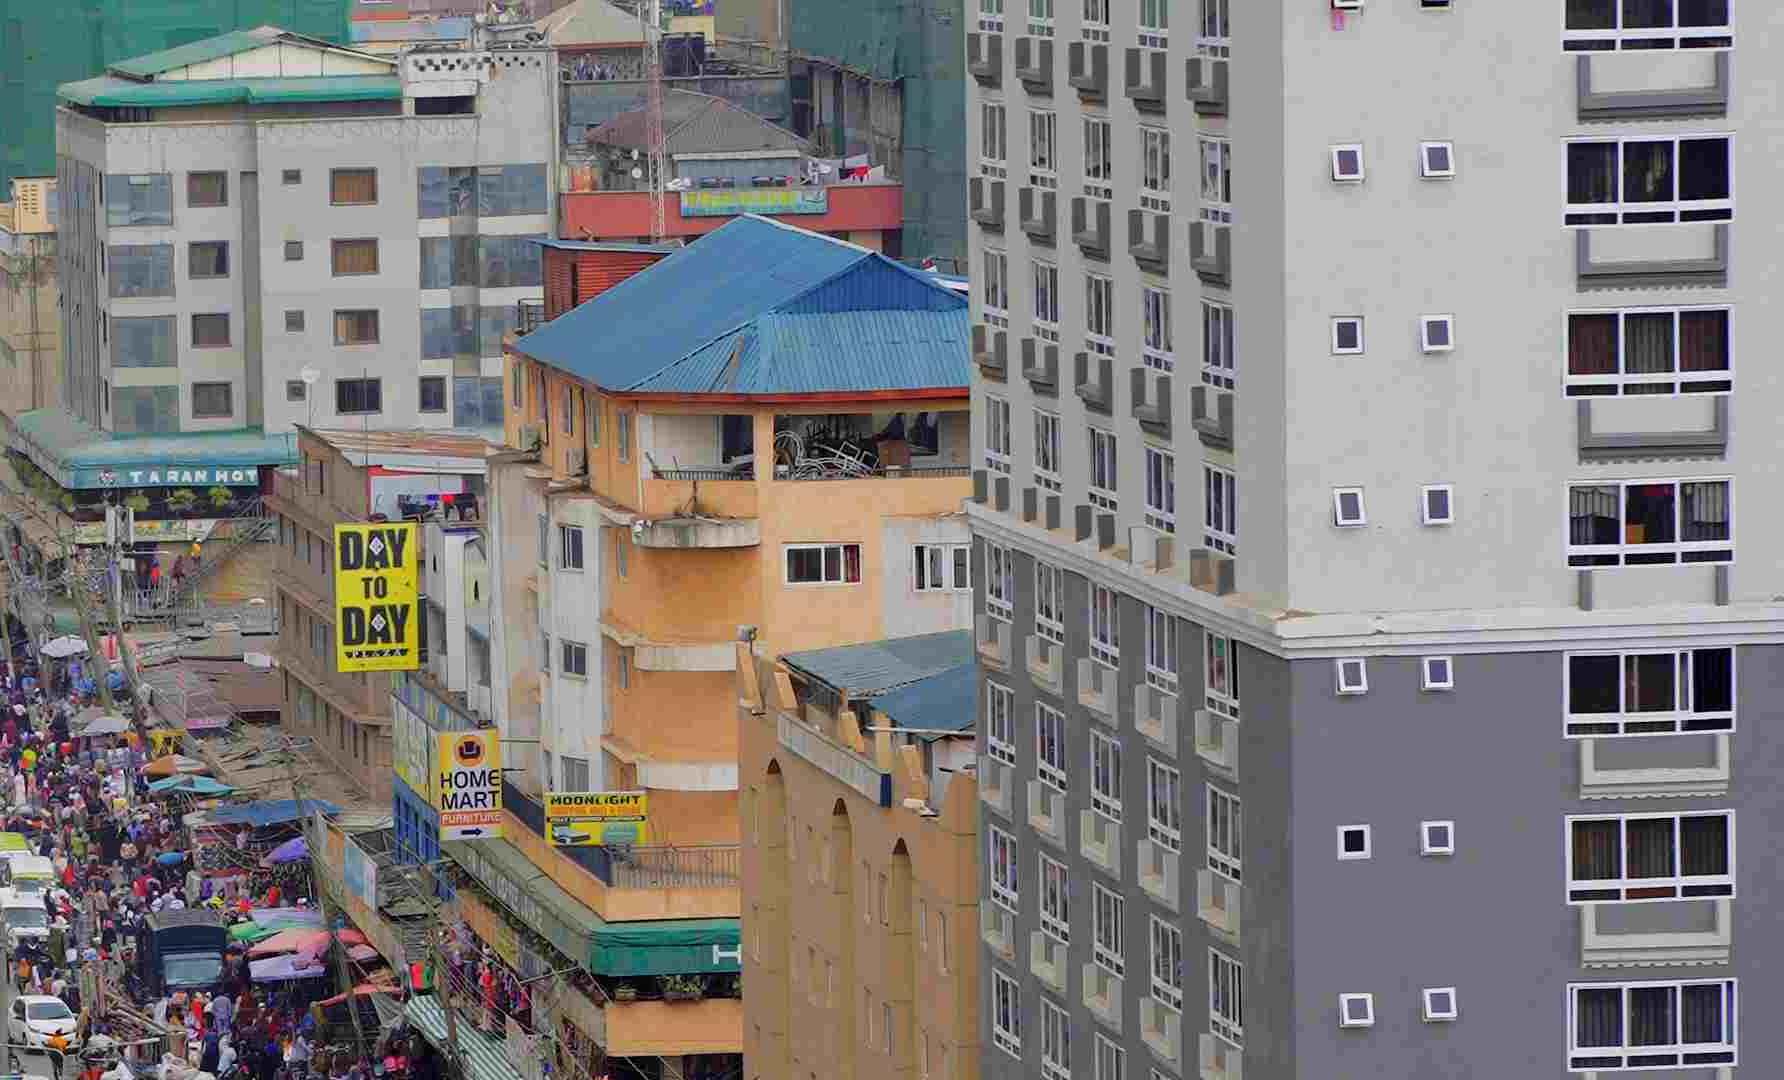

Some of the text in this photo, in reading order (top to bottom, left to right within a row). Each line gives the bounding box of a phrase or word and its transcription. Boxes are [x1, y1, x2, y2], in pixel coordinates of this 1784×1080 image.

[339, 528, 408, 570] DAY
[361, 575, 388, 599] TO
[342, 604, 410, 646] DAY
[440, 768, 501, 789] HOME
[441, 790, 501, 810] MART
[551, 795, 641, 806] MOONLIGHT
